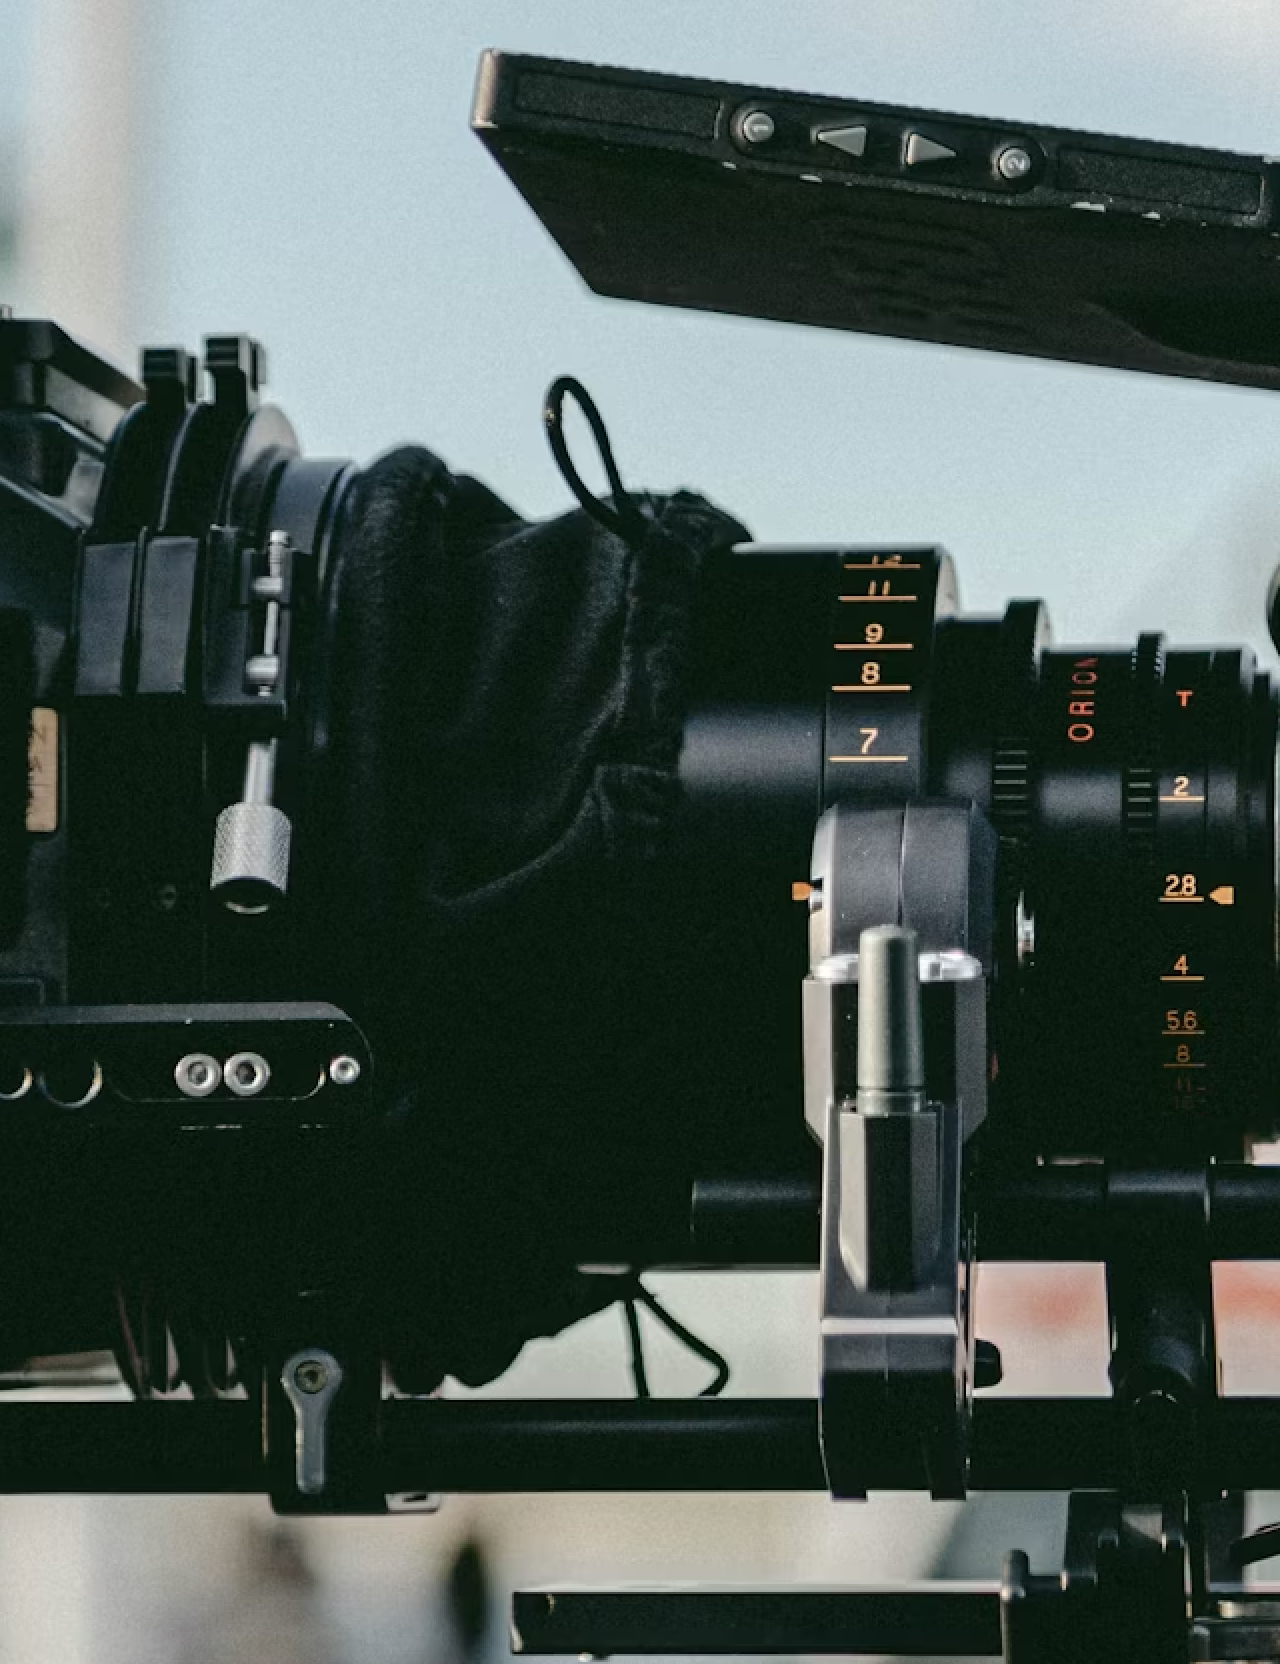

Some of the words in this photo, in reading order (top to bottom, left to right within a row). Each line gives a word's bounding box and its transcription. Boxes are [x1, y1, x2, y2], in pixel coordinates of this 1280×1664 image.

[868, 579, 891, 597] 11
[865, 622, 884, 643] 9
[861, 661, 880, 685] 8
[1175, 689, 1194, 707] T
[859, 727, 879, 754] 7
[1174, 775, 1189, 796] 2
[1173, 953, 1189, 975] 4
[1175, 1044, 1191, 1063] 8
